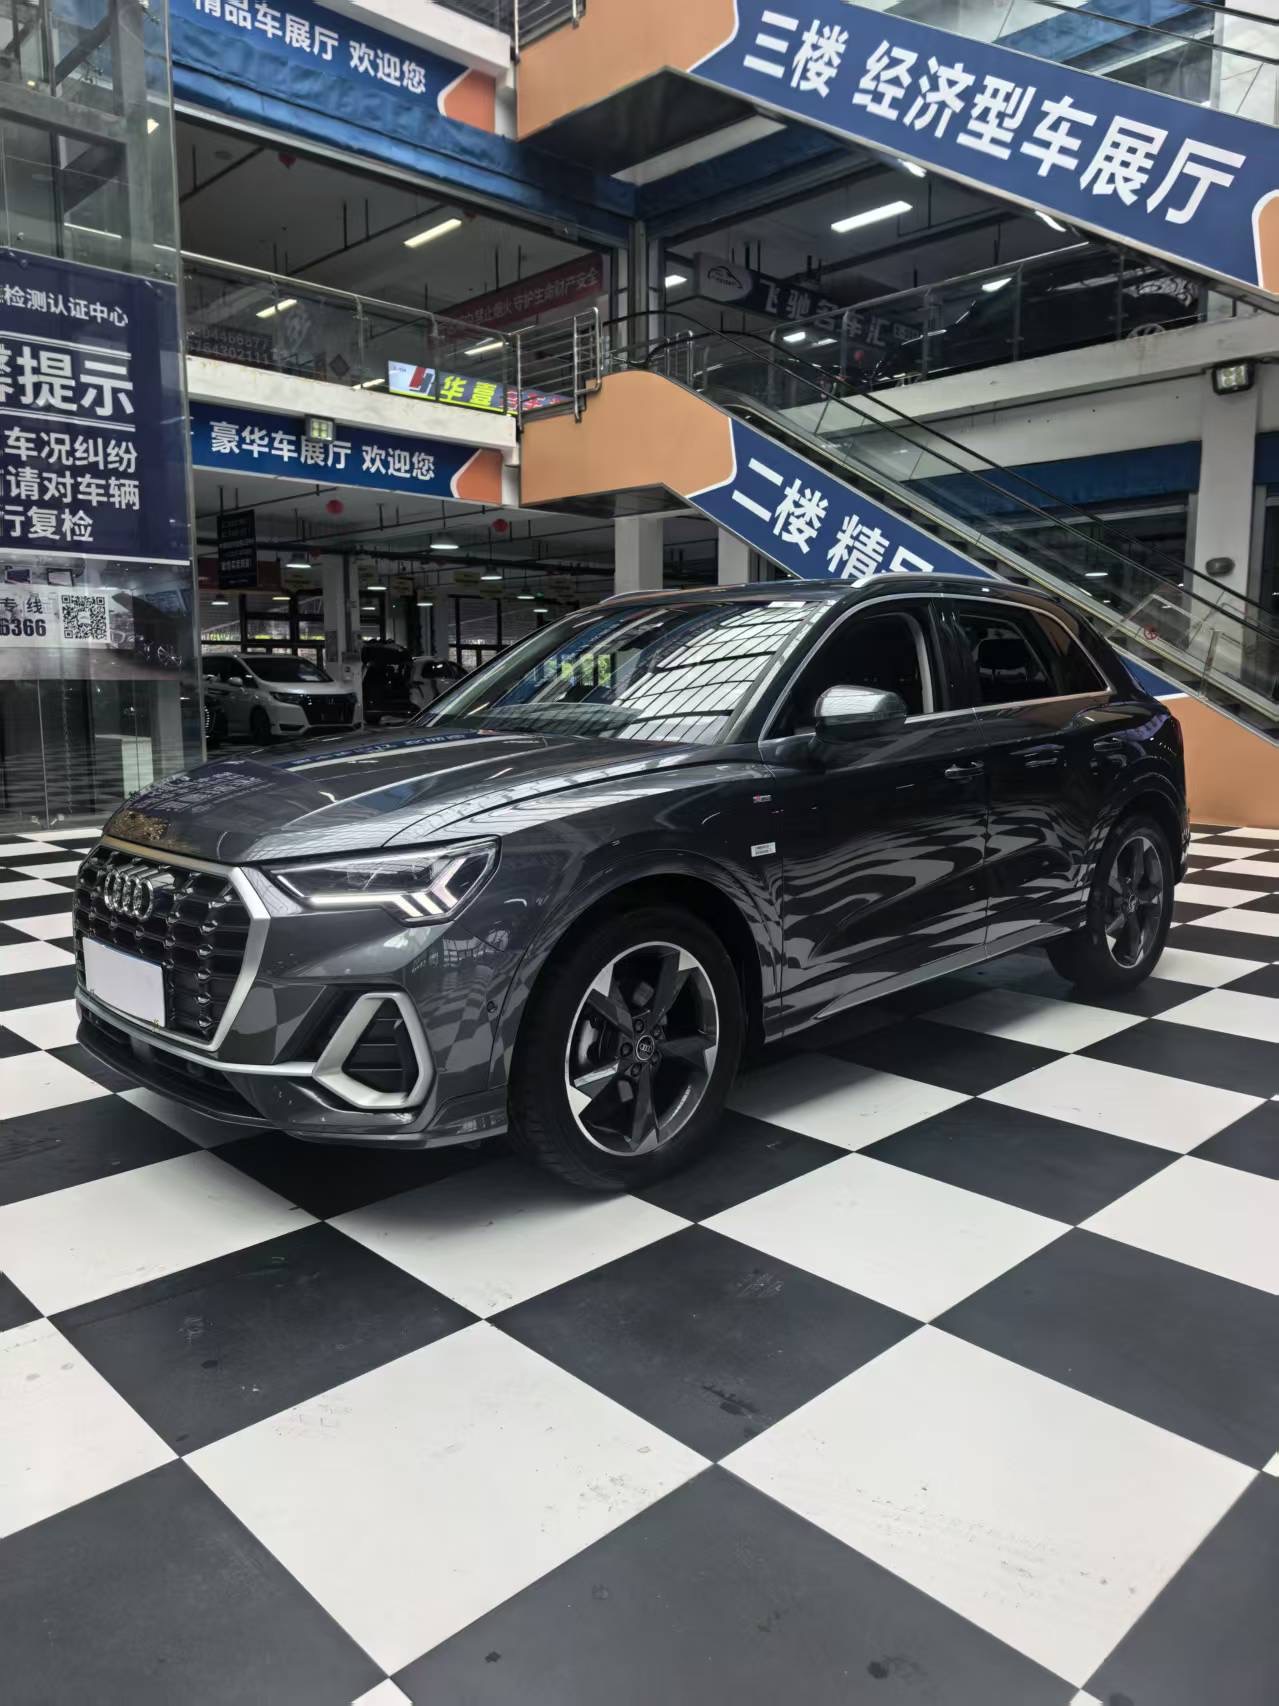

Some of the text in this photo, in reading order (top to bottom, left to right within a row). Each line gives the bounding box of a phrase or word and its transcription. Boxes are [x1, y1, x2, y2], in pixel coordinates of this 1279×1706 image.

[349, 39, 426, 95] 欢迎您
[742, 10, 1247, 225] 三楼 经济型车展厅
[0, 284, 129, 327] 检测认证中心
[0, 344, 135, 416] 提示
[3, 426, 138, 473] 车况纠纷
[209, 420, 435, 481] 豪华车展厅 欢迎您
[0, 465, 140, 510] 请对车辆
[731, 457, 829, 554] 二楼
